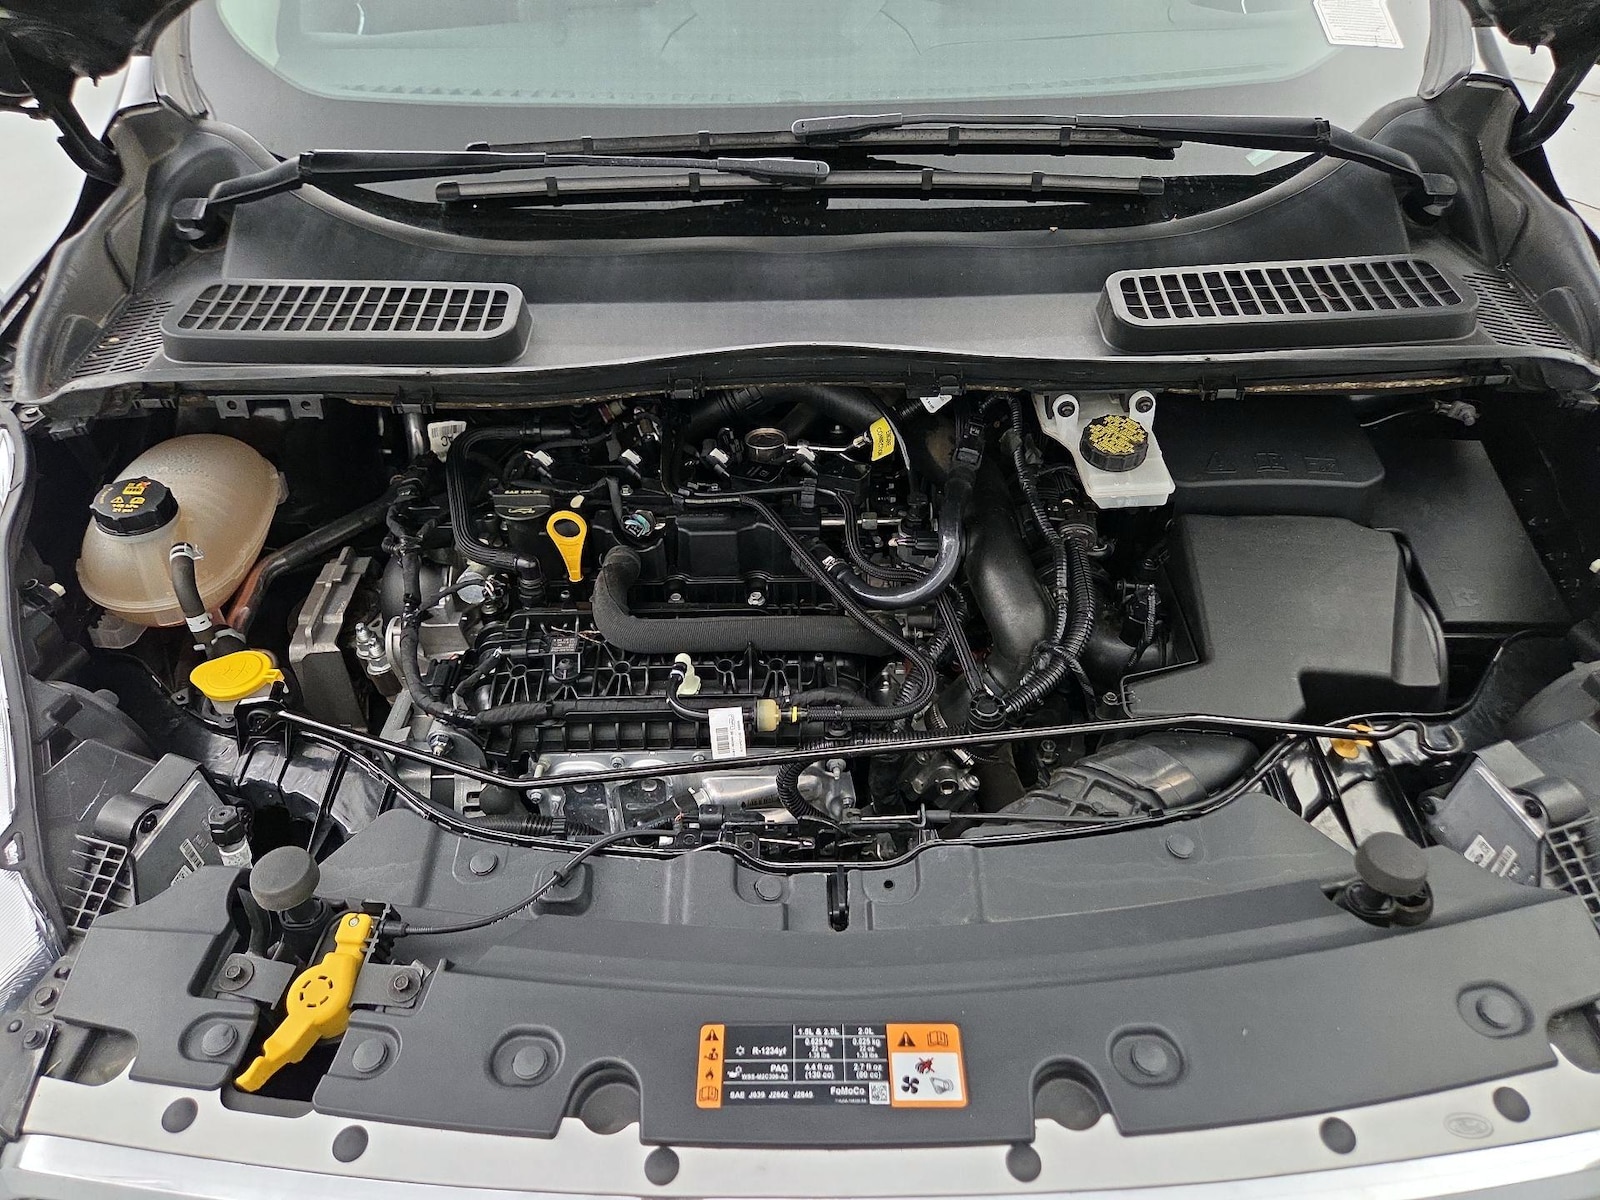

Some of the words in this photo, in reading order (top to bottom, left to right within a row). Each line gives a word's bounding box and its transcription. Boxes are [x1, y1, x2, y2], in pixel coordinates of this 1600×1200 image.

[857, 1026, 875, 1035] 2.0L
[824, 1037, 833, 1048] kg
[871, 1037, 881, 1048] kg
[751, 1046, 787, 1057] R-1234yf
[770, 1063, 789, 1073] PAG
[729, 1090, 745, 1100] SAE
[830, 1086, 866, 1096] FoMoCo
